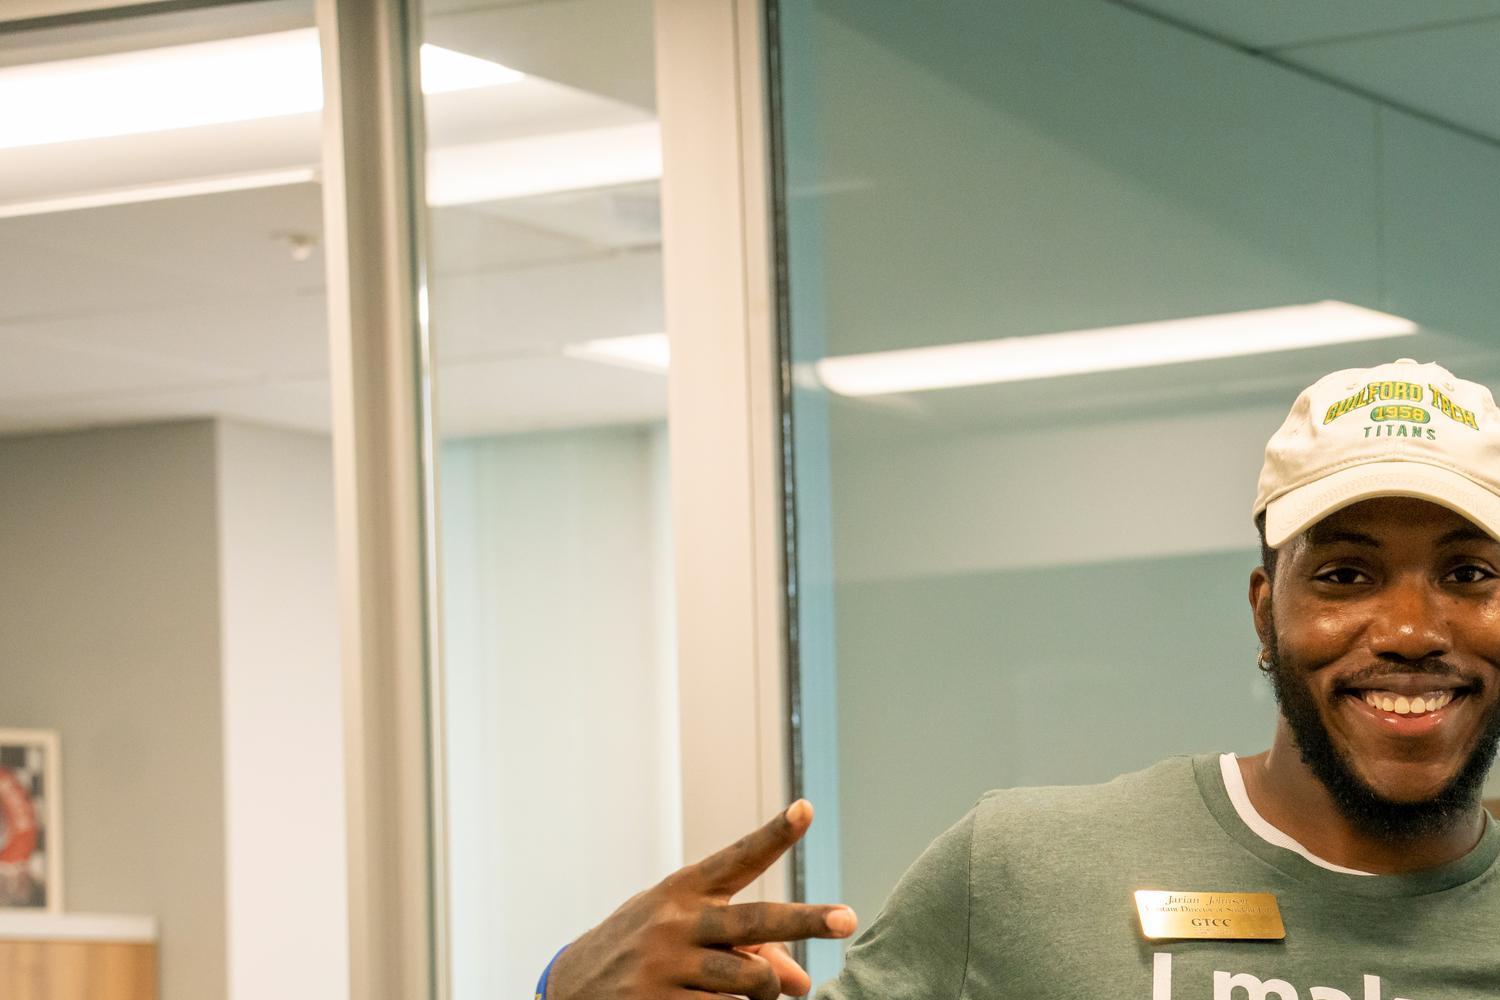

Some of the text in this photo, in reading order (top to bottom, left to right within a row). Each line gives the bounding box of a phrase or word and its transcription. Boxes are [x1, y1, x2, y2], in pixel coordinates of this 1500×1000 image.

[1322, 381, 1480, 431] GUILFORD TECH
[1375, 405, 1426, 422] 1958
[1363, 424, 1437, 441] TITANS
[1191, 918, 1233, 927] GTCC
